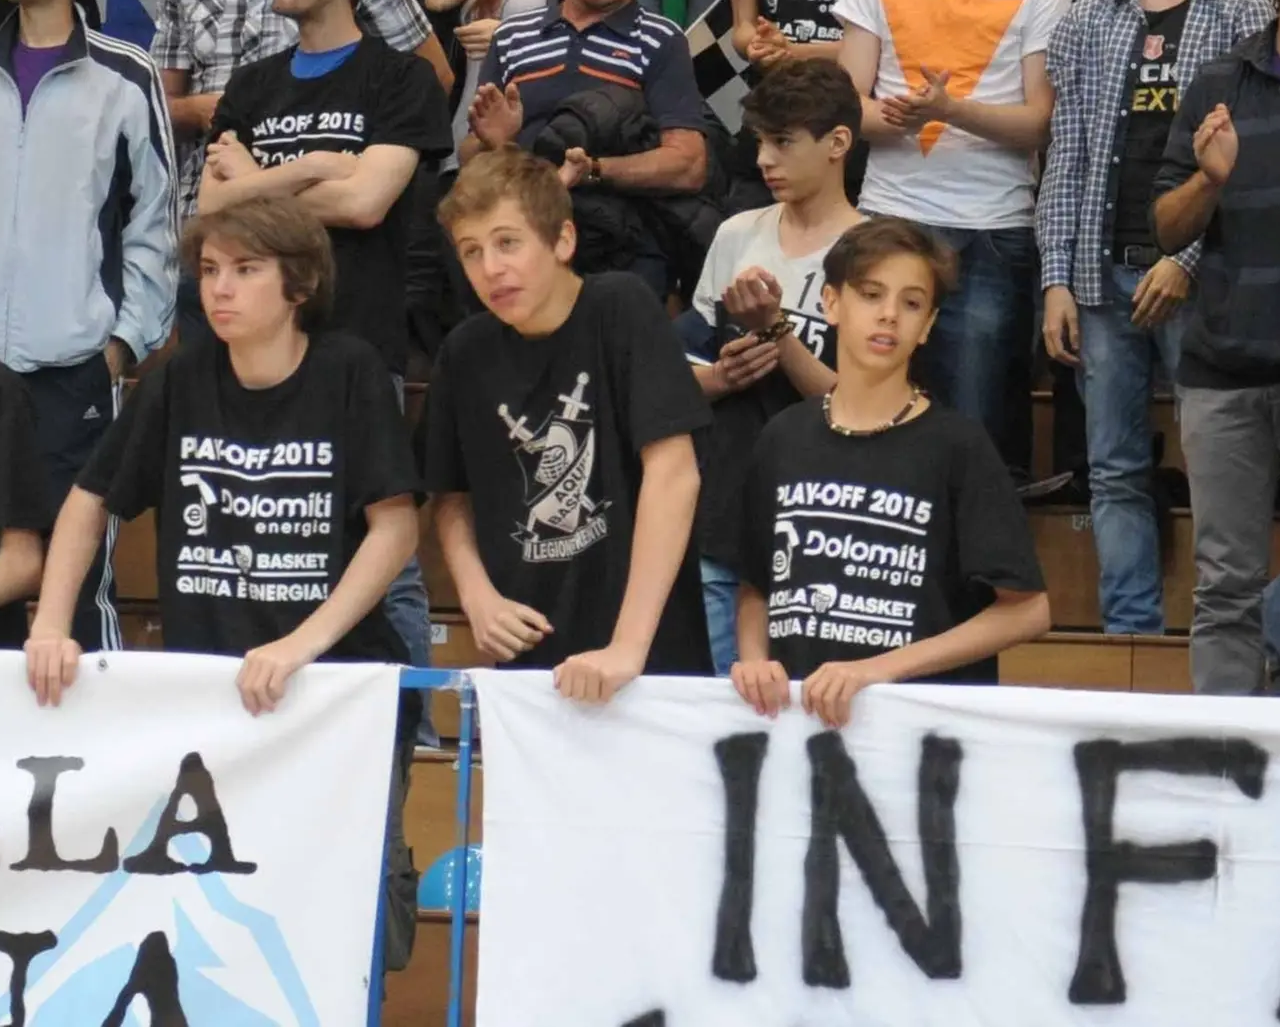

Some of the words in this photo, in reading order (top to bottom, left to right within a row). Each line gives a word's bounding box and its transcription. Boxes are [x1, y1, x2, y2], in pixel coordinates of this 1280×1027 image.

[317, 111, 365, 132] 2015
[272, 441, 333, 467] 2015
[220, 491, 333, 520] Dolomiti
[868, 489, 934, 525] 2015
[254, 520, 332, 538] energia
[256, 553, 329, 571] BASKET
[803, 529, 927, 573] Dolomiti
[843, 563, 925, 587] energia
[839, 594, 917, 619] BASKET
[820, 622, 913, 648] ENERGIA!
[712, 730, 964, 988] IN
